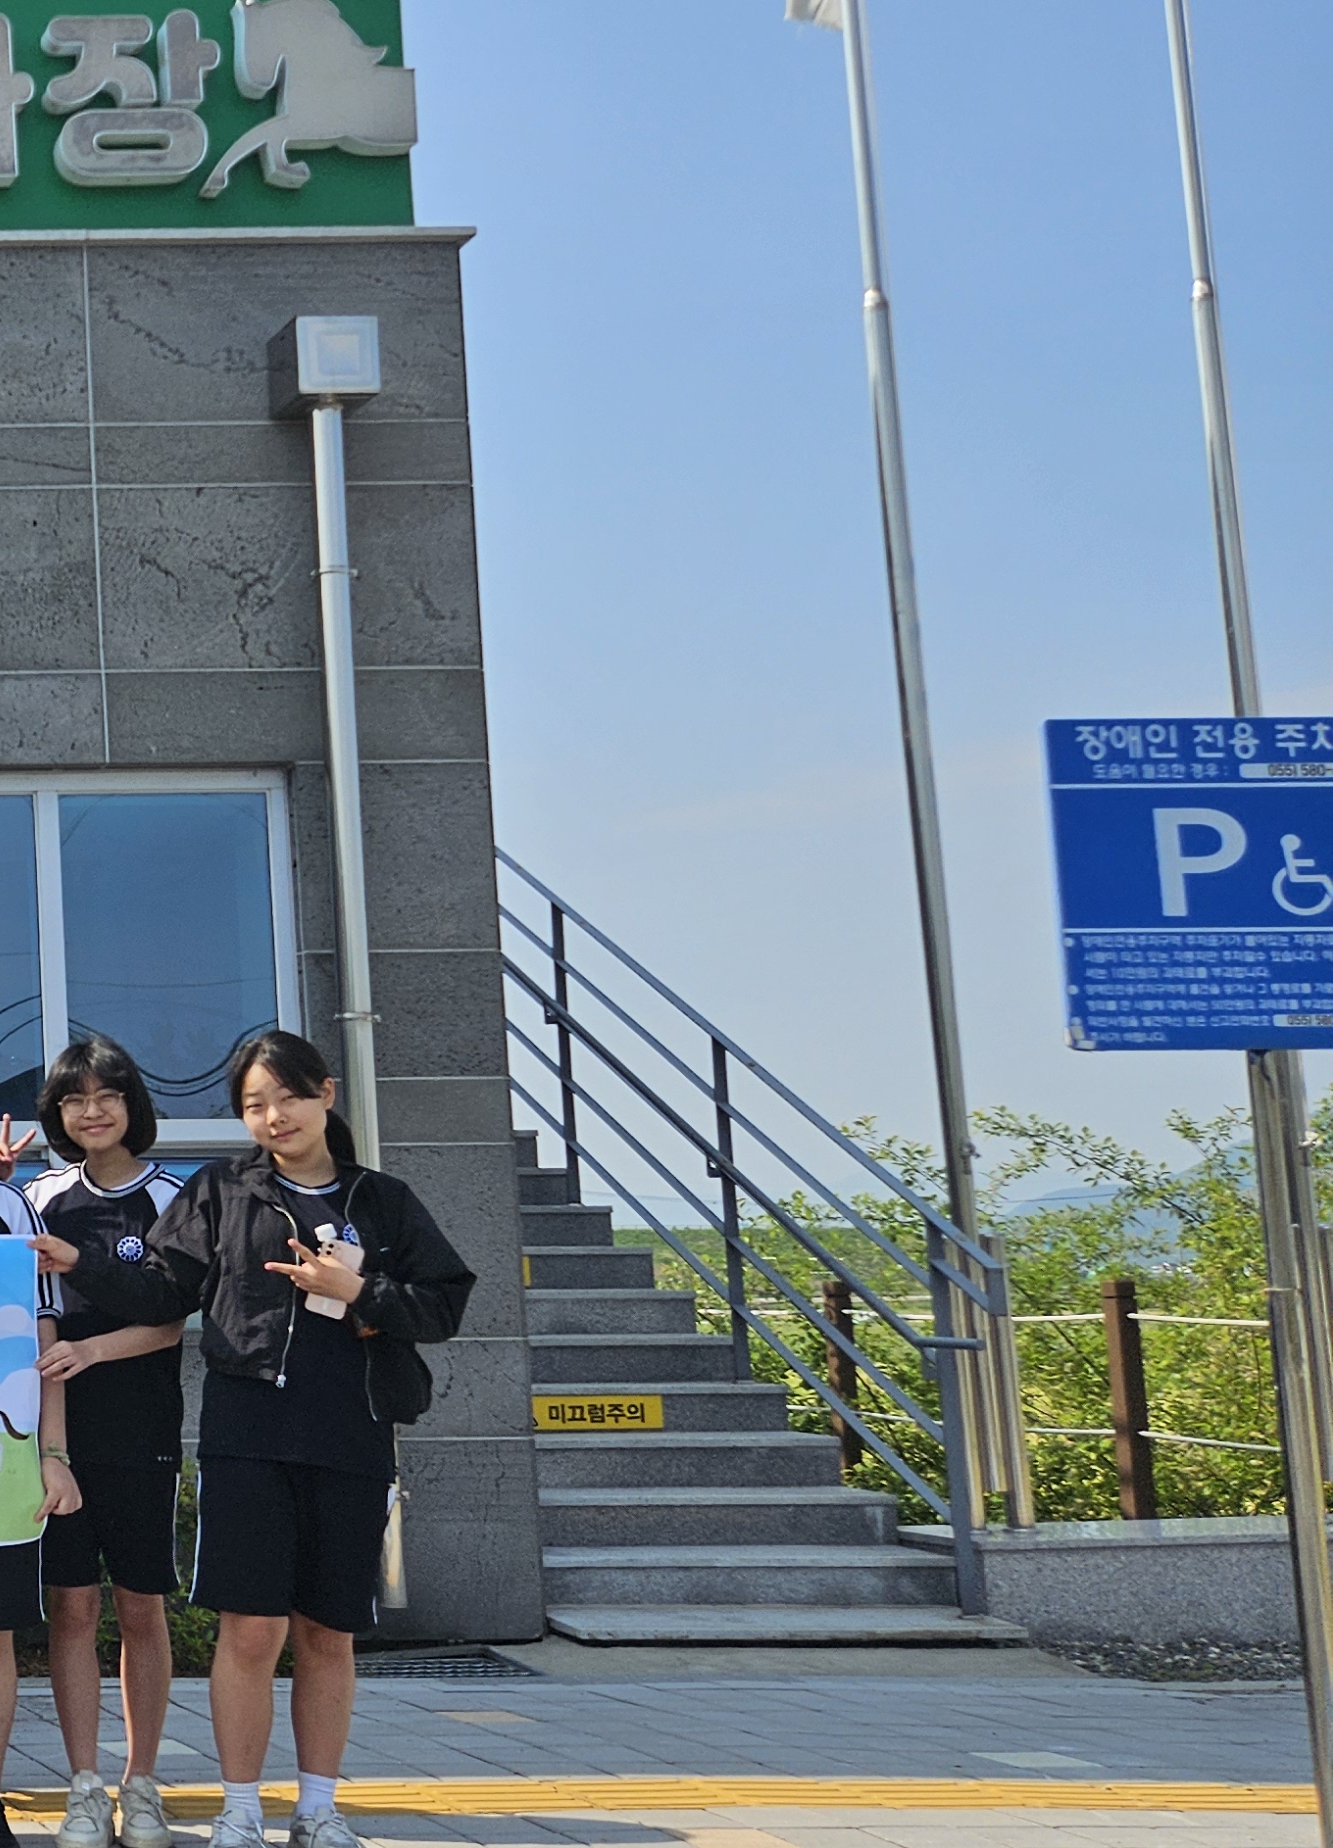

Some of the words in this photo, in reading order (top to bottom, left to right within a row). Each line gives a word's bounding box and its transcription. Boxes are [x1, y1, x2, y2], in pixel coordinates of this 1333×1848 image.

[1075, 724, 1179, 761] 장애인
[1192, 722, 1260, 760] 전용
[1152, 807, 1248, 917] P
[548, 1402, 646, 1424] 미끄럼주의
